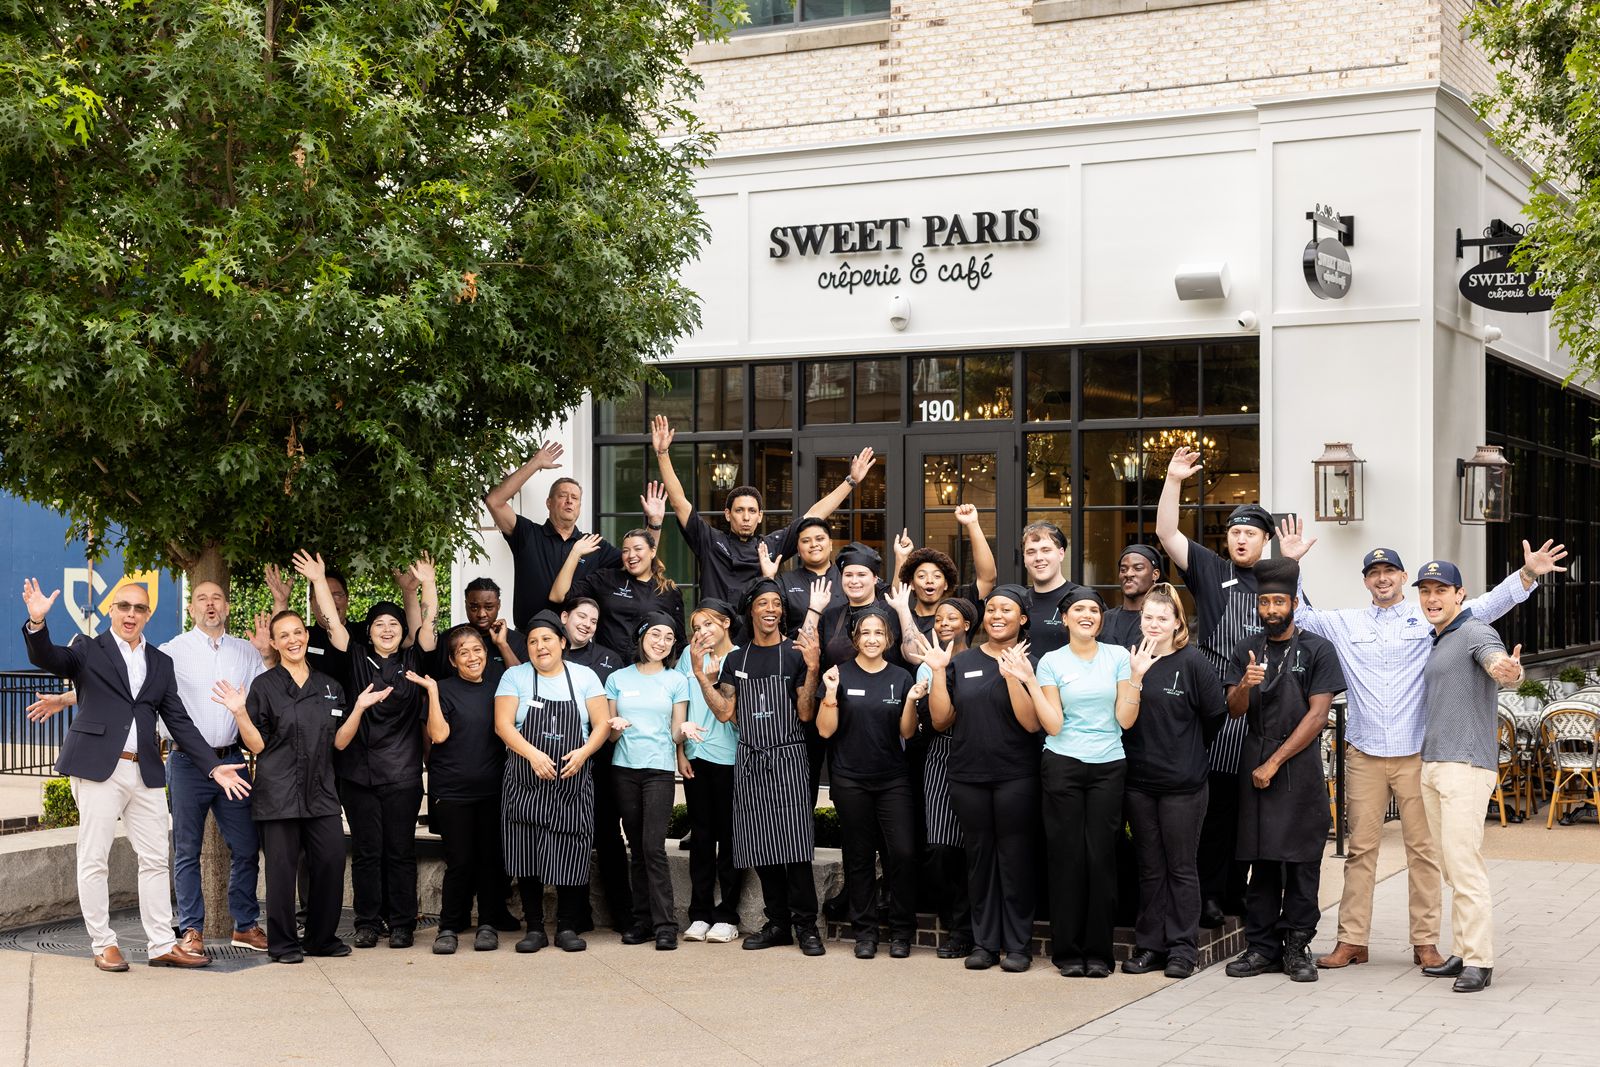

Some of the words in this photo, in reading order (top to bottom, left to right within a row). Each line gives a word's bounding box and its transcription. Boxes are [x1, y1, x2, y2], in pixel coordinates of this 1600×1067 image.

[769, 217, 910, 259] SWEET
[922, 207, 1040, 248] PARIS
[818, 261, 901, 294] crêperie
[909, 252, 927, 284] &
[938, 253, 994, 290] café
[1468, 272, 1529, 287] SWEET
[918, 399, 955, 422] 190
